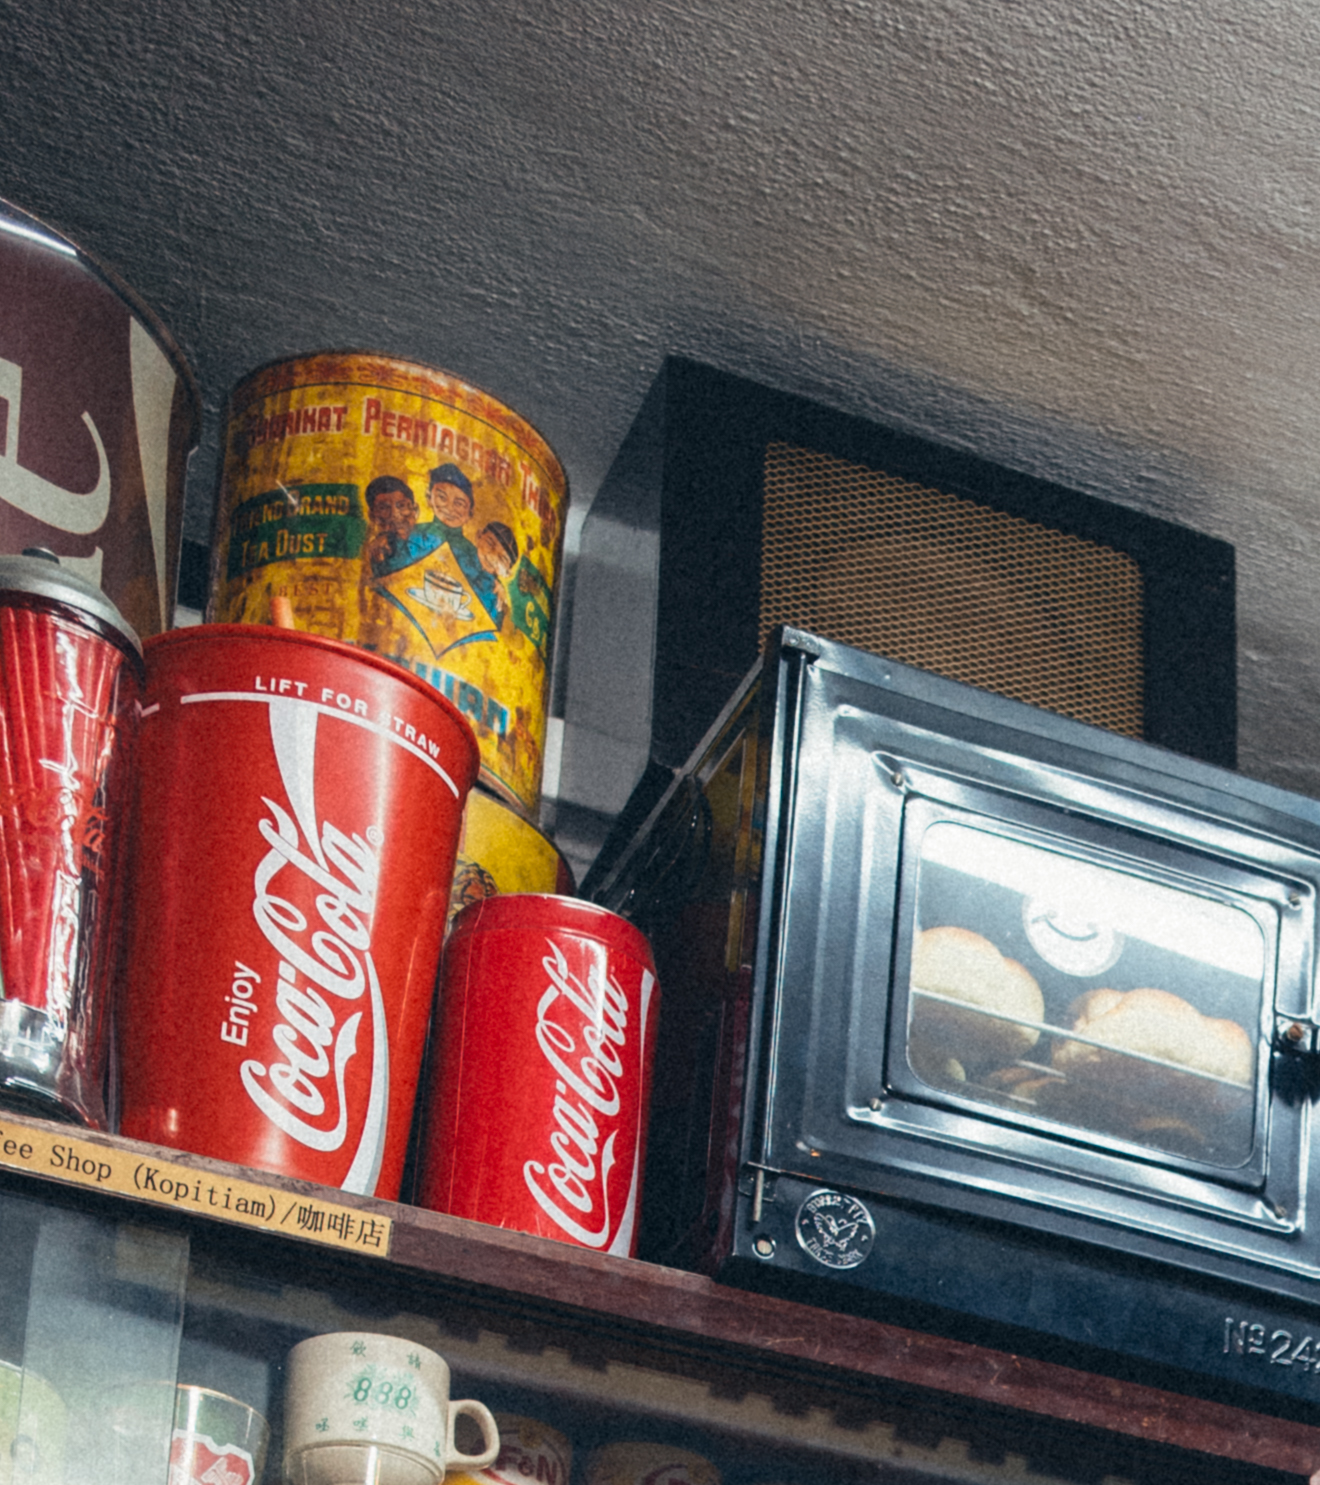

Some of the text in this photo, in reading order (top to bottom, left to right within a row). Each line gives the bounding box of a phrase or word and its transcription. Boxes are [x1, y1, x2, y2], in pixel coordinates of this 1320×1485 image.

[275, 531, 329, 558] DUST
[255, 675, 441, 759] LIFT FOR STRAW
[220, 960, 262, 1047] Enjoy
[49, 1144, 113, 1182] Shop
